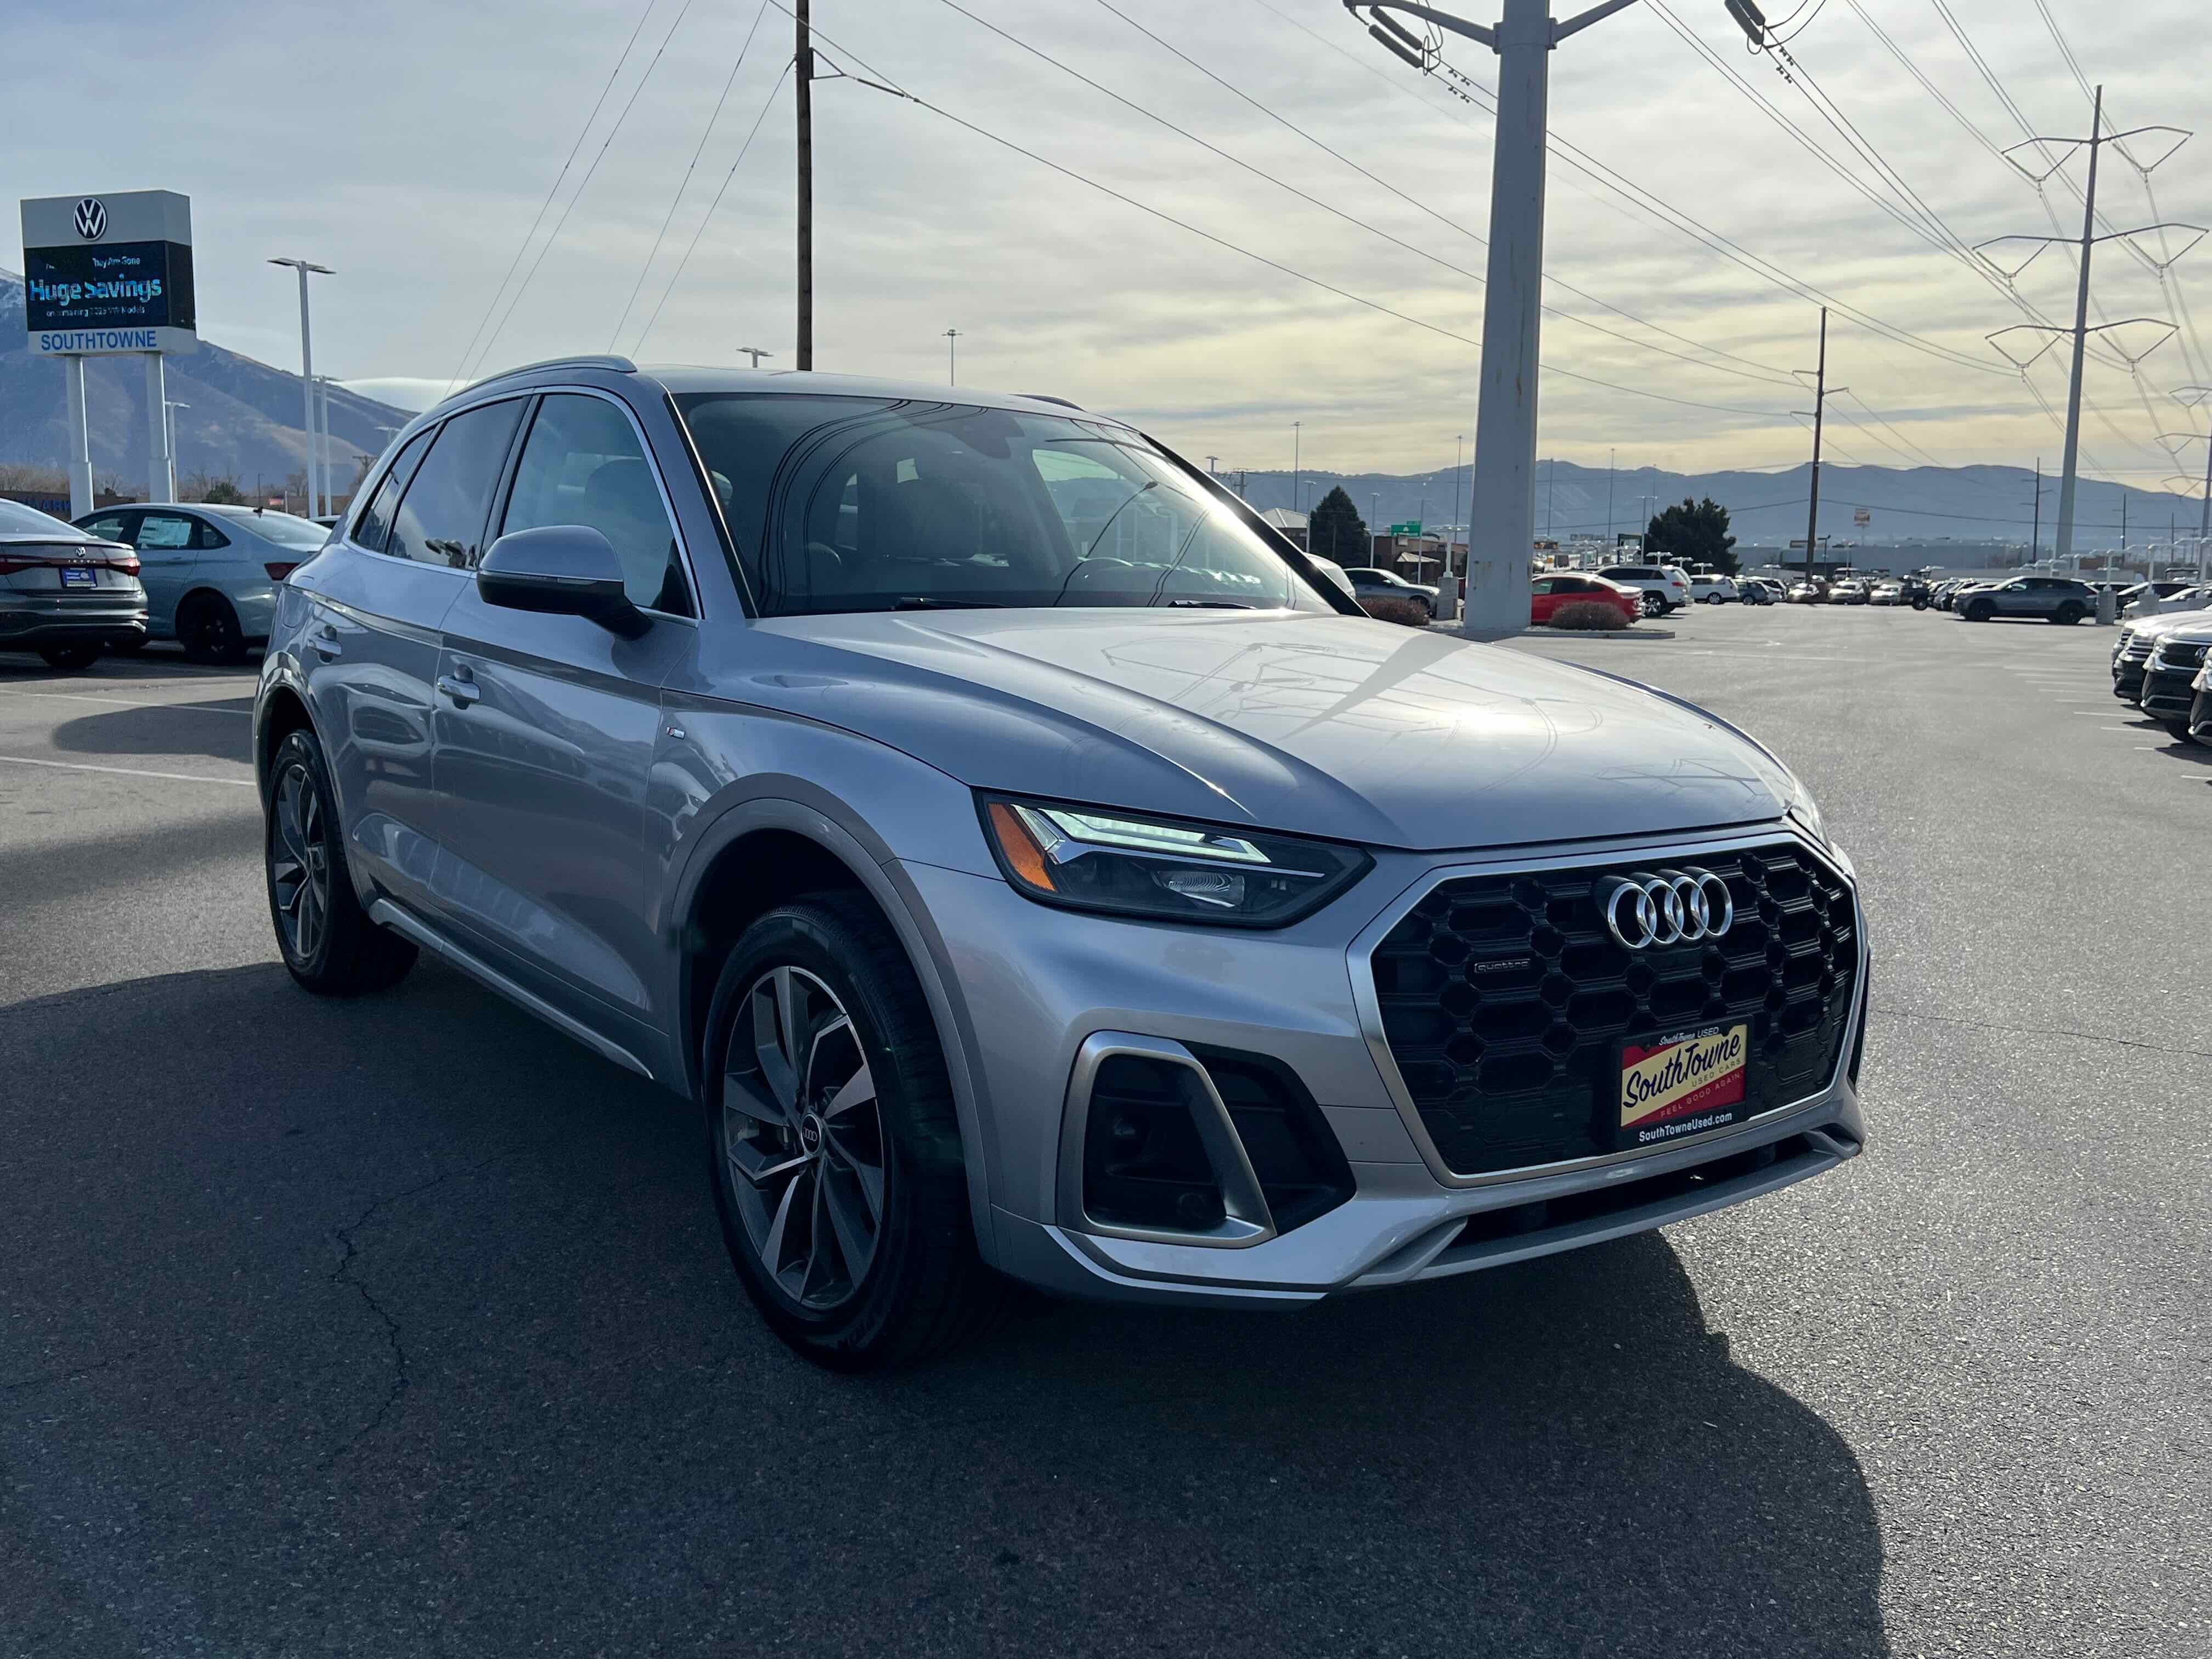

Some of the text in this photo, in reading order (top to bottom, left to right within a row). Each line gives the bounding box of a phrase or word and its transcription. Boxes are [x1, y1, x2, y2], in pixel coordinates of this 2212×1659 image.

[29, 279, 81, 306] Huge
[41, 330, 157, 351] SOUTHTOWNE
[1697, 1026, 1719, 1038] USED
[1623, 1034, 1741, 1108] SouthTowne
[1691, 1057, 1741, 1088] USED CARS
[1660, 1103, 1683, 1118] FEEL
[1686, 1087, 1711, 1105] GOOD
[1639, 1111, 1733, 1143] SouthTowneUsed.com
